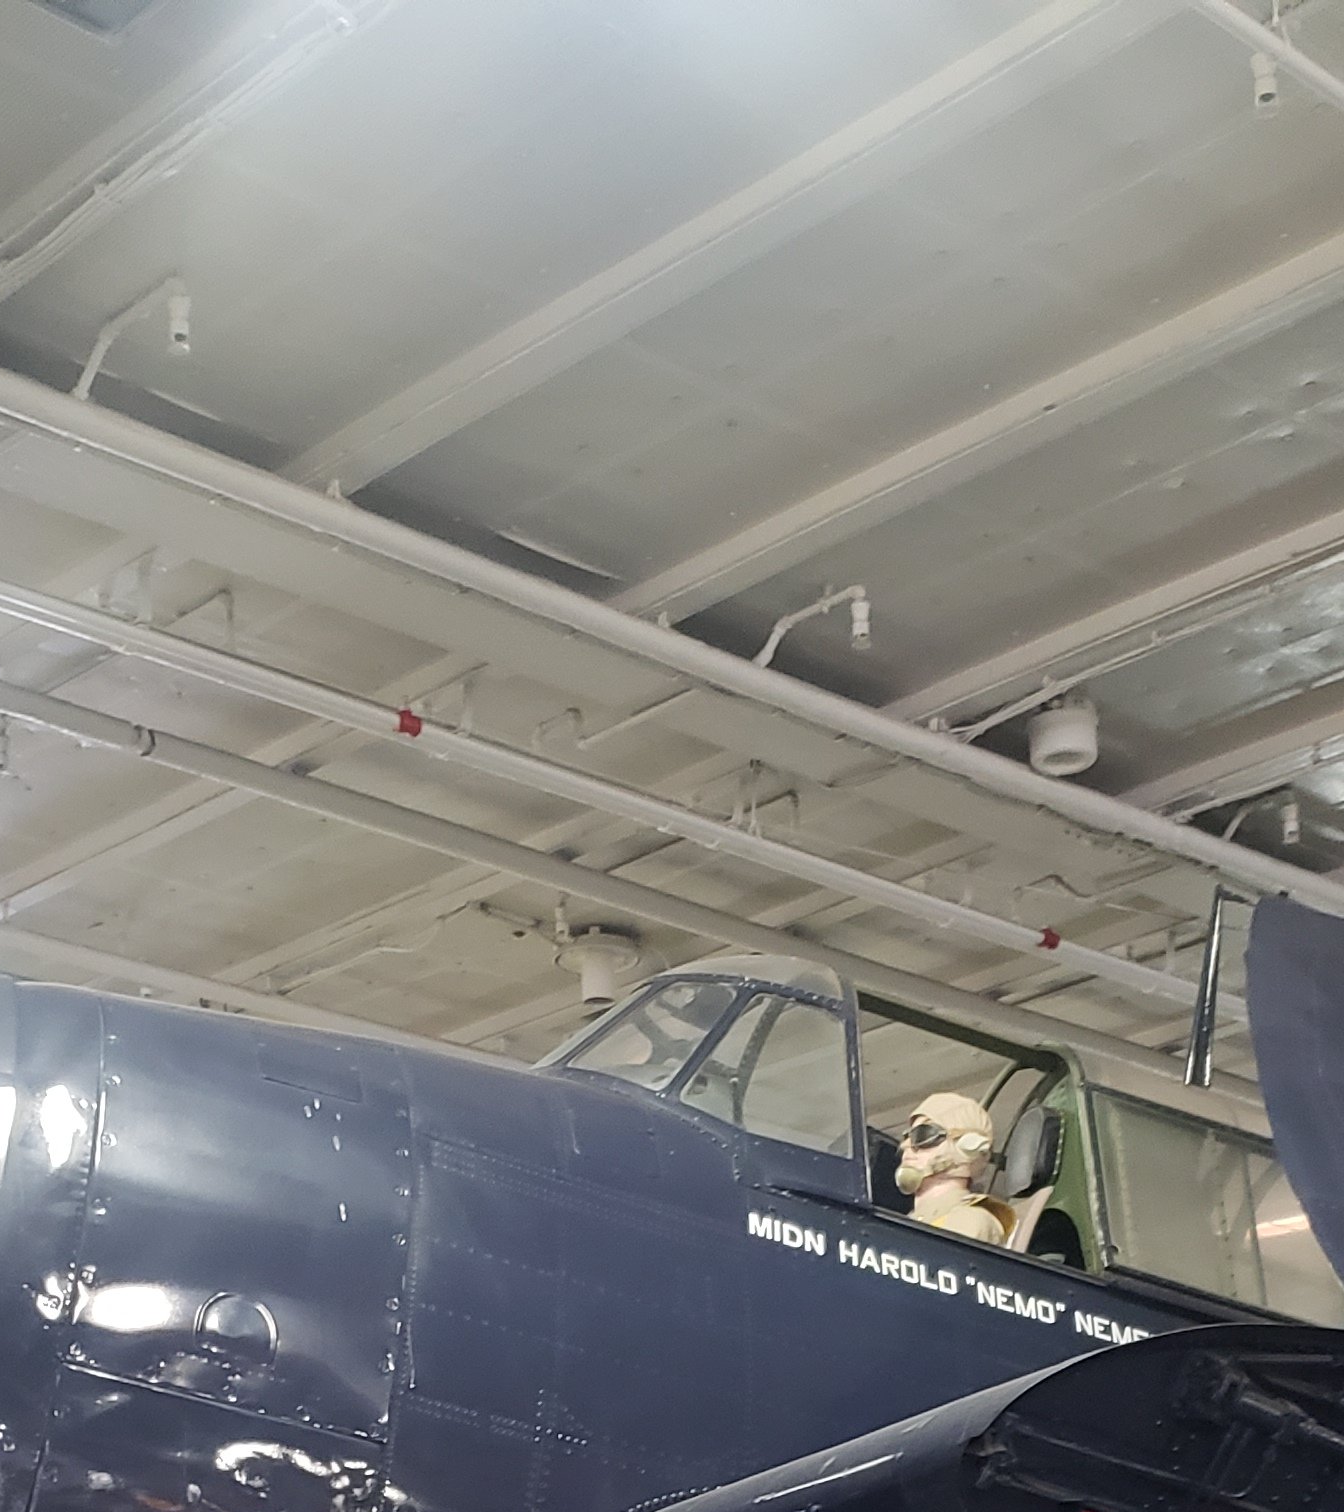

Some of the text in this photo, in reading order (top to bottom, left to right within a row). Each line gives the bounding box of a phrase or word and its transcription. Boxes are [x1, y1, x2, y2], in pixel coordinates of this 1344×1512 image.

[746, 1211, 826, 1256] MIDN
[838, 1239, 958, 1296] HAROLD
[965, 1275, 1066, 1325] "NEMO"
